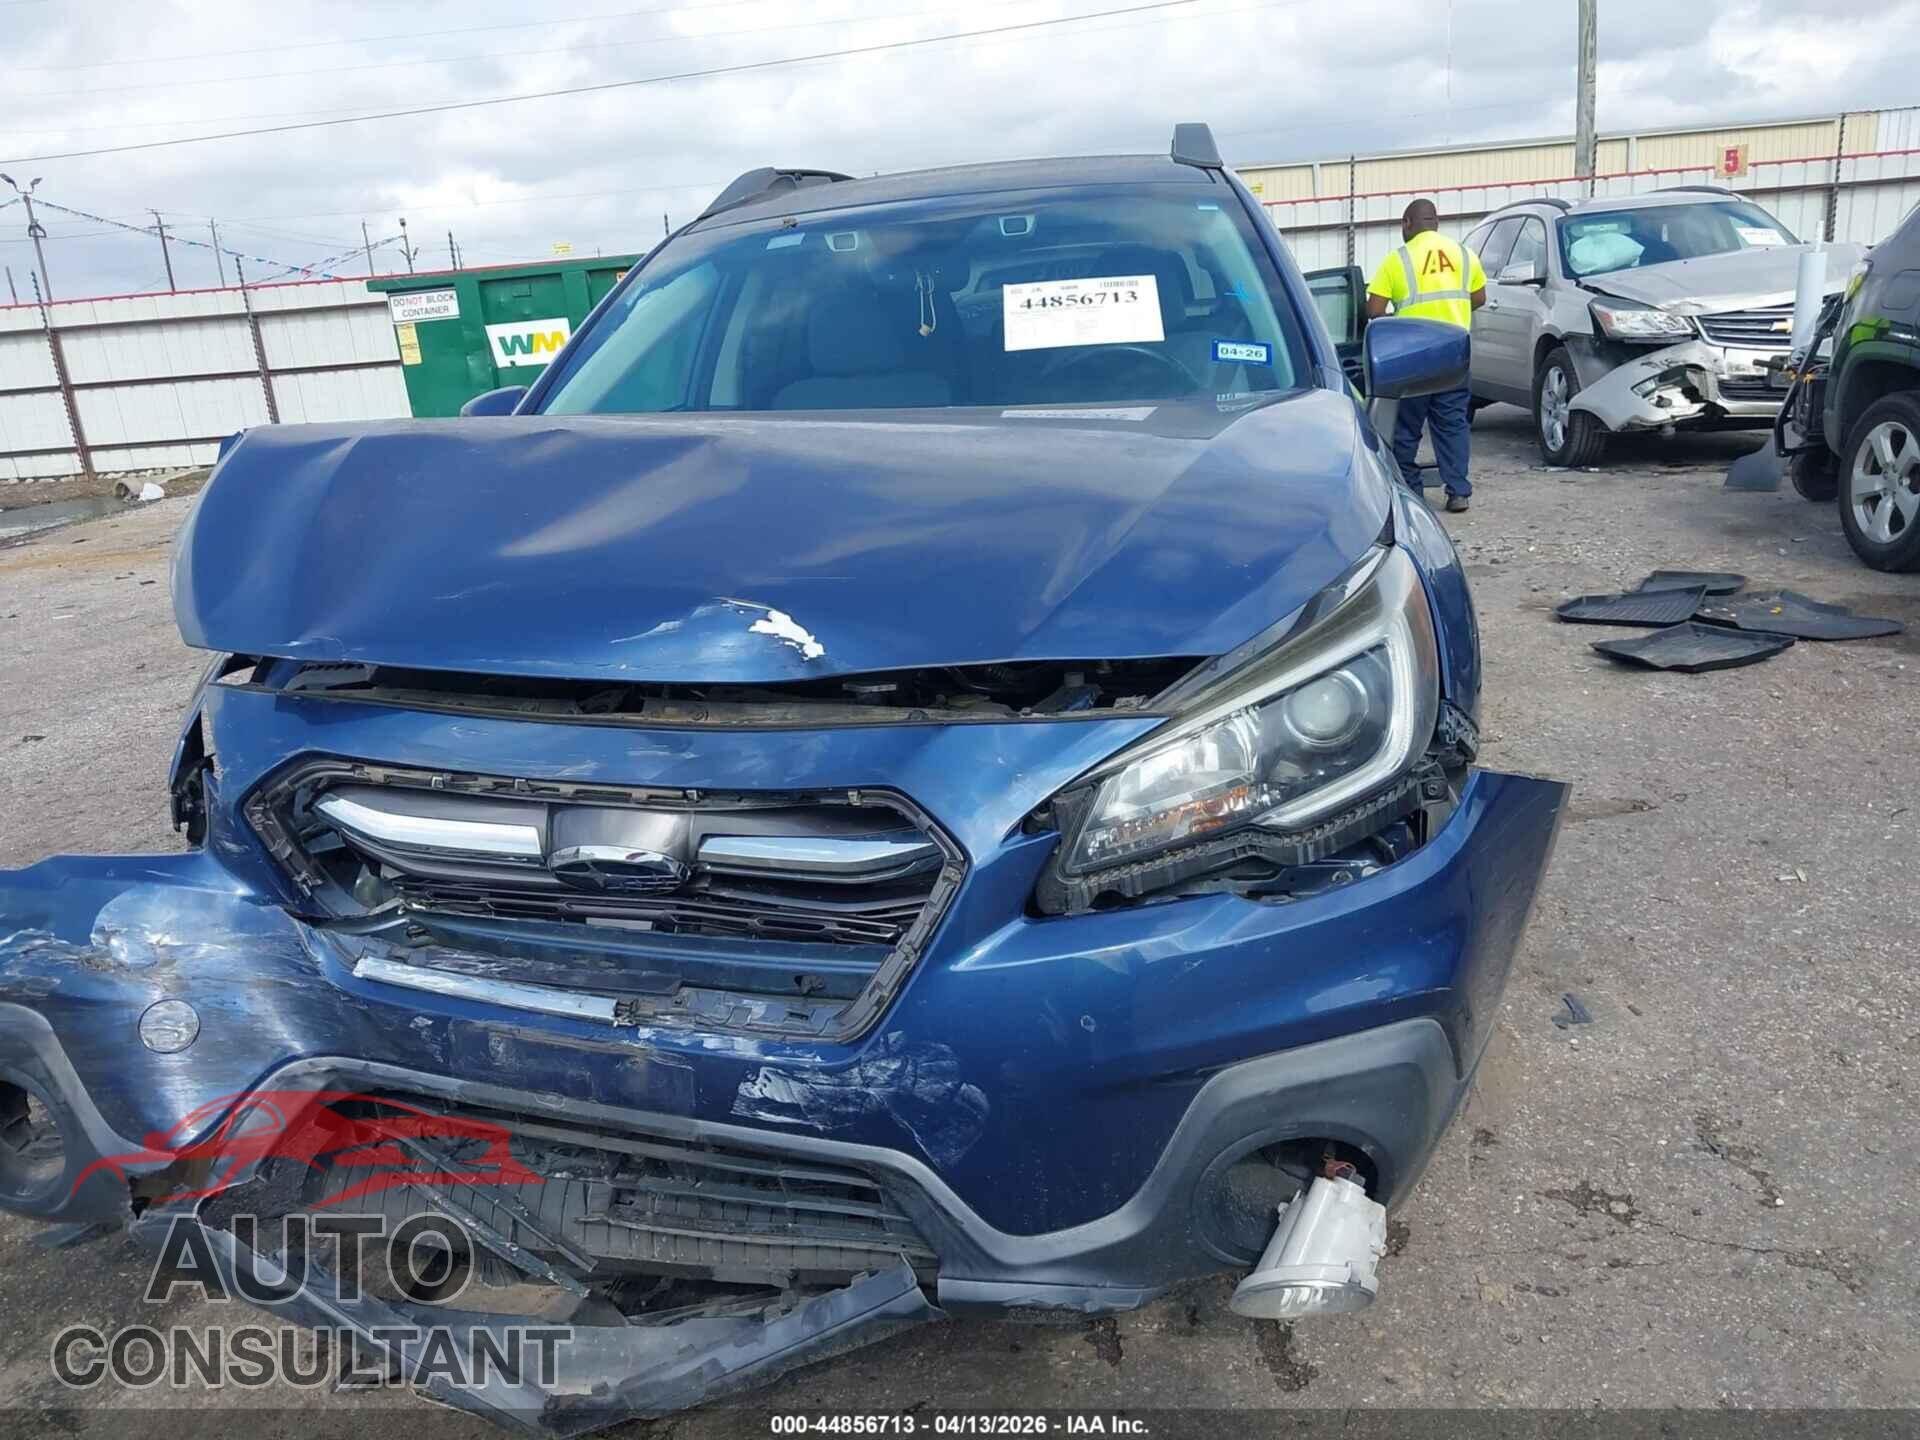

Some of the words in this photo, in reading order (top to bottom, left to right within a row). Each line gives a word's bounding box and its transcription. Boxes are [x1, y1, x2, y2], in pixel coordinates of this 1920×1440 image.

[1725, 149, 1738, 173] 5
[393, 298, 405, 307] DO
[405, 296, 423, 306] NOT
[426, 293, 456, 304] BLOCK
[1020, 290, 1138, 310] 44856713
[402, 305, 449, 318] CONTAINER
[498, 331, 565, 356] WM
[1220, 346, 1264, 359] 04-26
